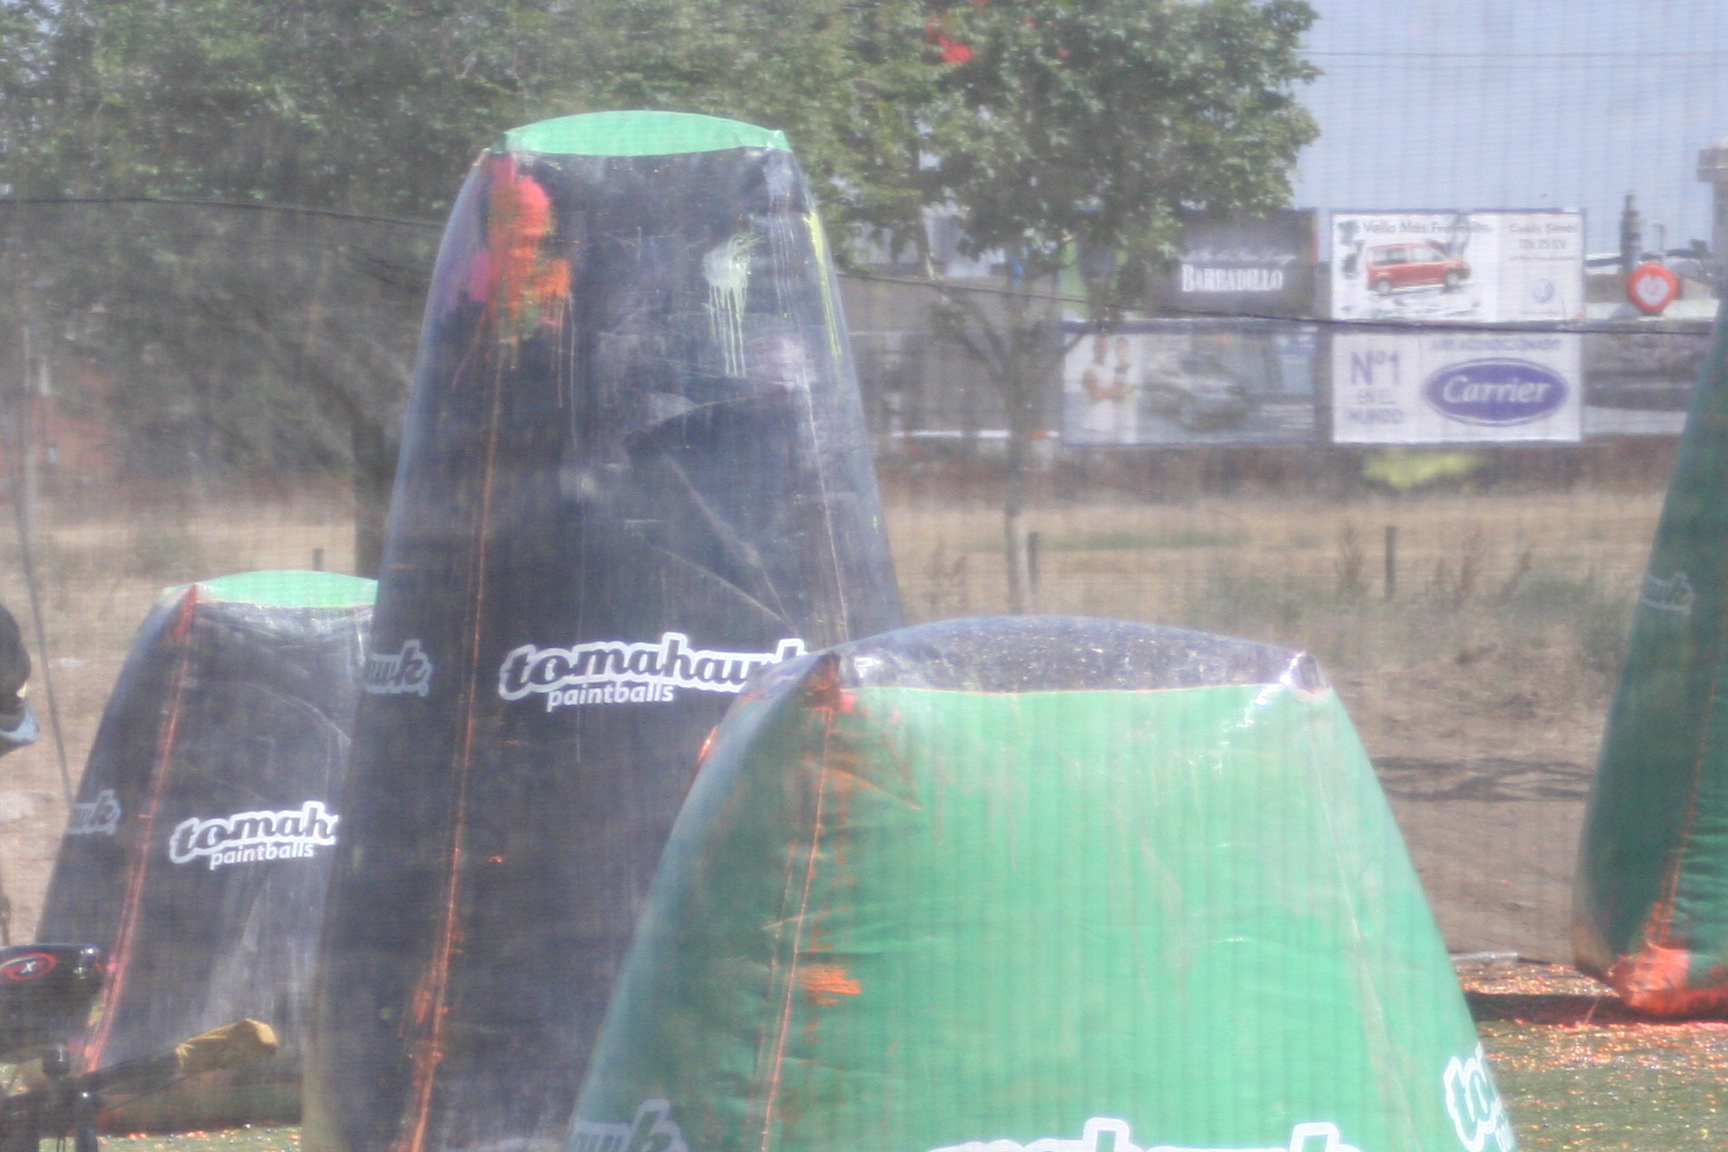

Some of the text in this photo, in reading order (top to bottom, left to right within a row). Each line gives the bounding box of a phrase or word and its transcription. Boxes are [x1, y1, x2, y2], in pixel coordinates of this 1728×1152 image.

[1443, 375, 1552, 403] Carrier
[498, 631, 808, 700] tomaha
[547, 681, 675, 712] paintballs
[169, 800, 338, 864] tomah
[209, 841, 315, 870] paintballs
